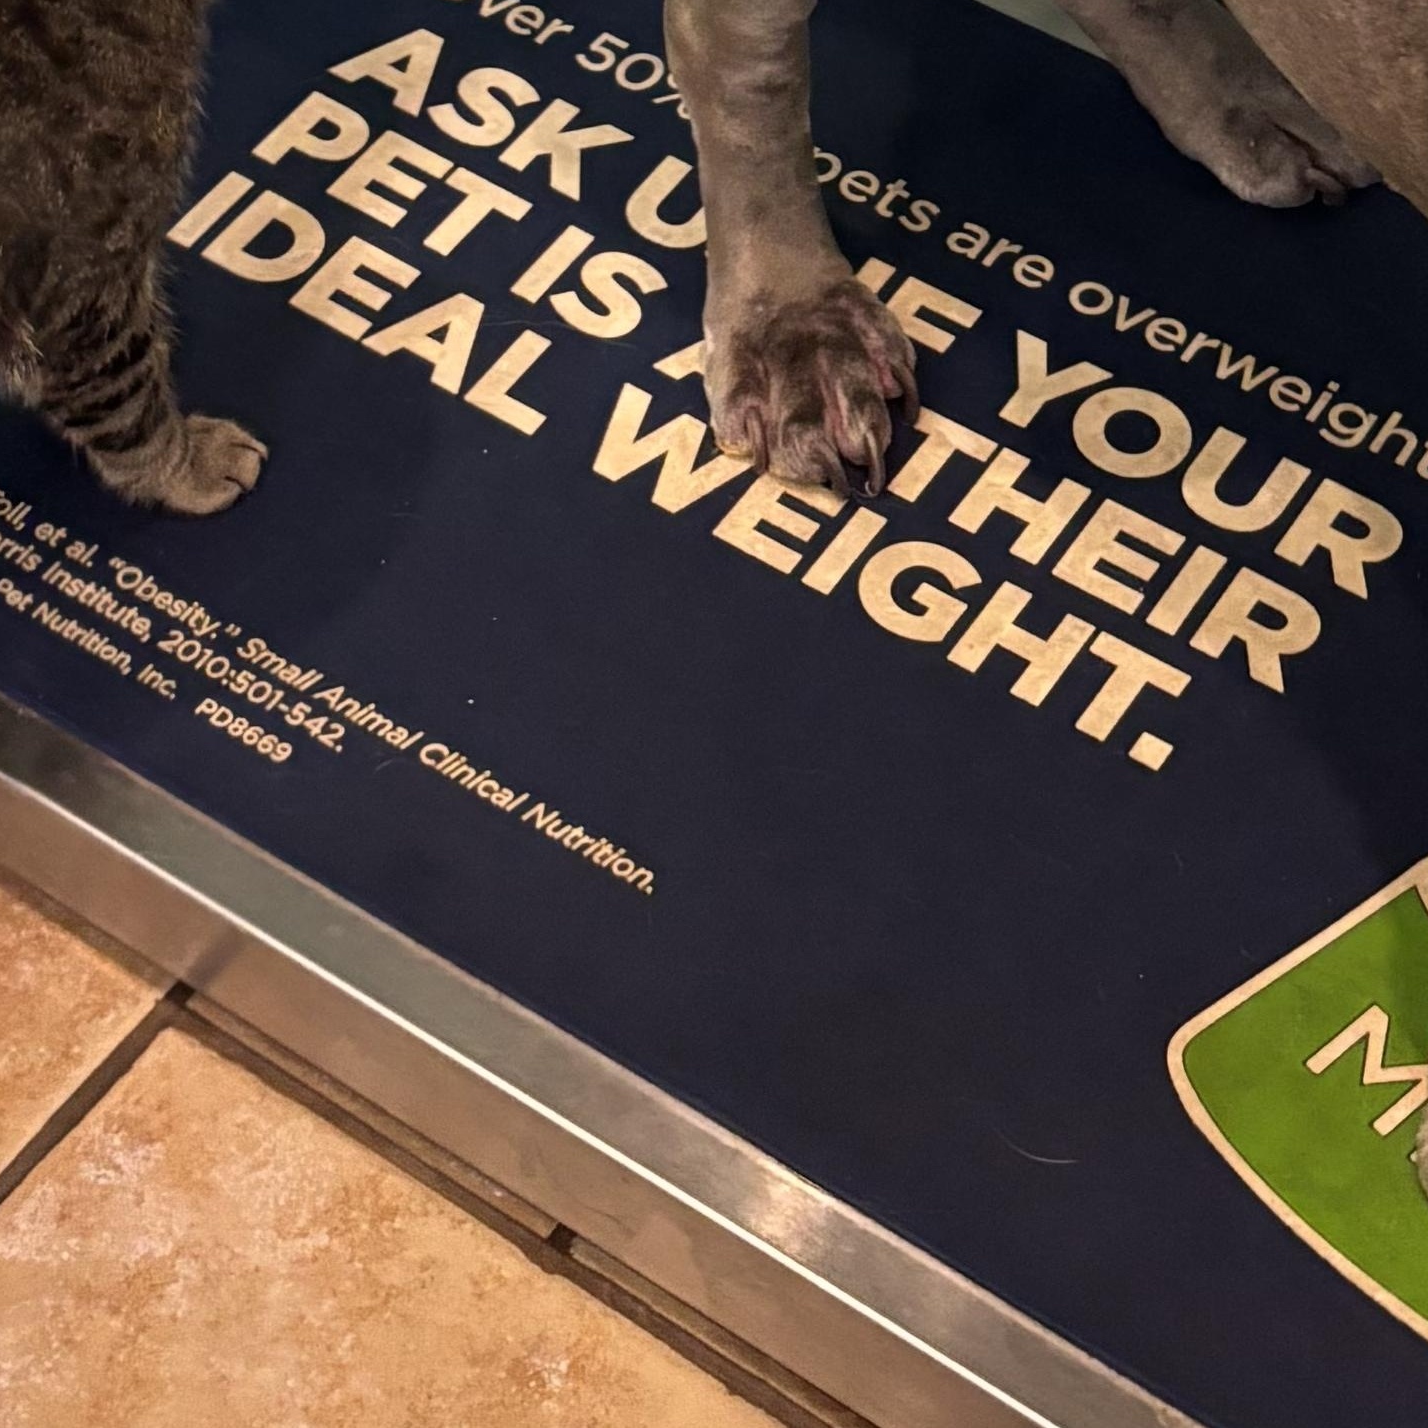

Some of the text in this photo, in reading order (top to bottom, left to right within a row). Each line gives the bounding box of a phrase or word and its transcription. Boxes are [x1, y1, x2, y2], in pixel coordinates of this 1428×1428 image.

[251, 90, 1322, 695] PET IS THEIR
[327, 28, 634, 202] ASK
[998, 330, 1404, 600] YOUR
[945, 221, 1055, 290] are
[40, 560, 153, 643] Institute,
[157, 629, 350, 754] 2010:501-542.
[165, 170, 1192, 772] IDEAL WEIGHT.
[31, 600, 135, 677] Nutrition,
[135, 662, 178, 700] Inc.
[193, 697, 294, 764] PD8669
[34, 521, 68, 548] et
[65, 543, 100, 569] al.
[236, 636, 323, 693] Small
[313, 685, 425, 752] Animal
[418, 741, 530, 814] Clinical
[520, 801, 658, 895] Nutrition.
